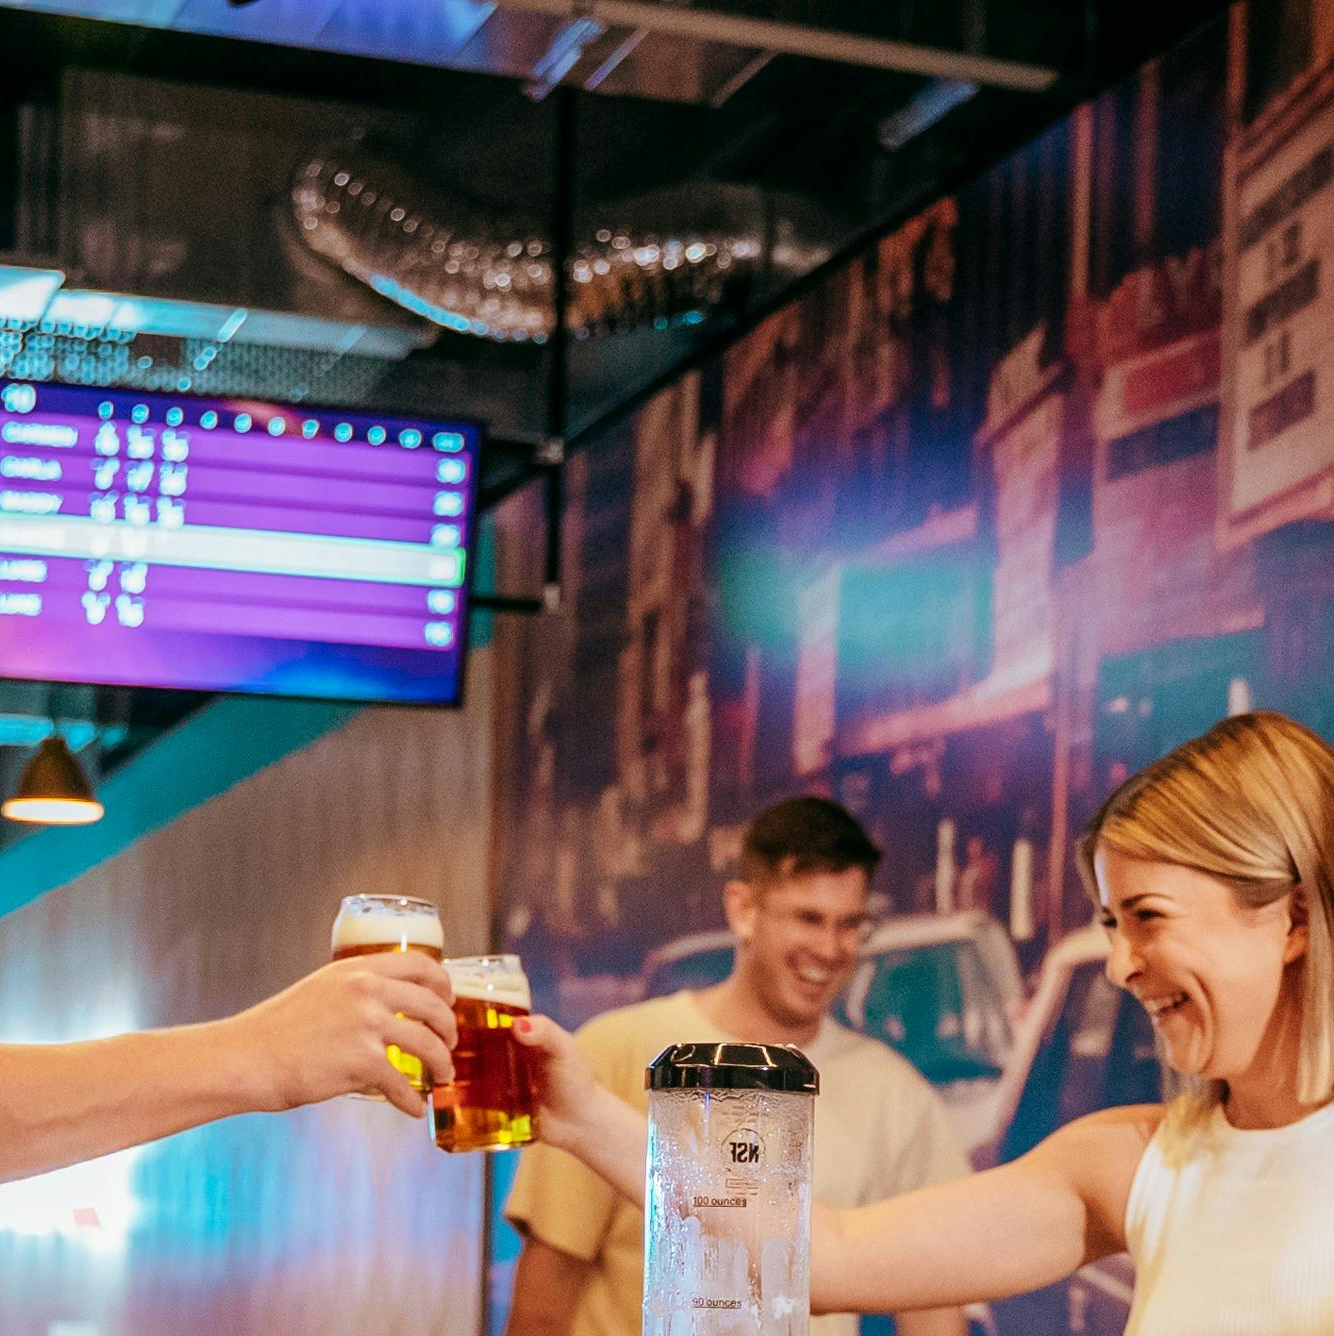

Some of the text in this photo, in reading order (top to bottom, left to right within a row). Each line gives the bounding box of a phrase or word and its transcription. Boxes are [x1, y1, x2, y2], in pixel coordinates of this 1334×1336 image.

[693, 1196, 747, 1206] 100 ounces
[706, 1299, 742, 1308] ounces
